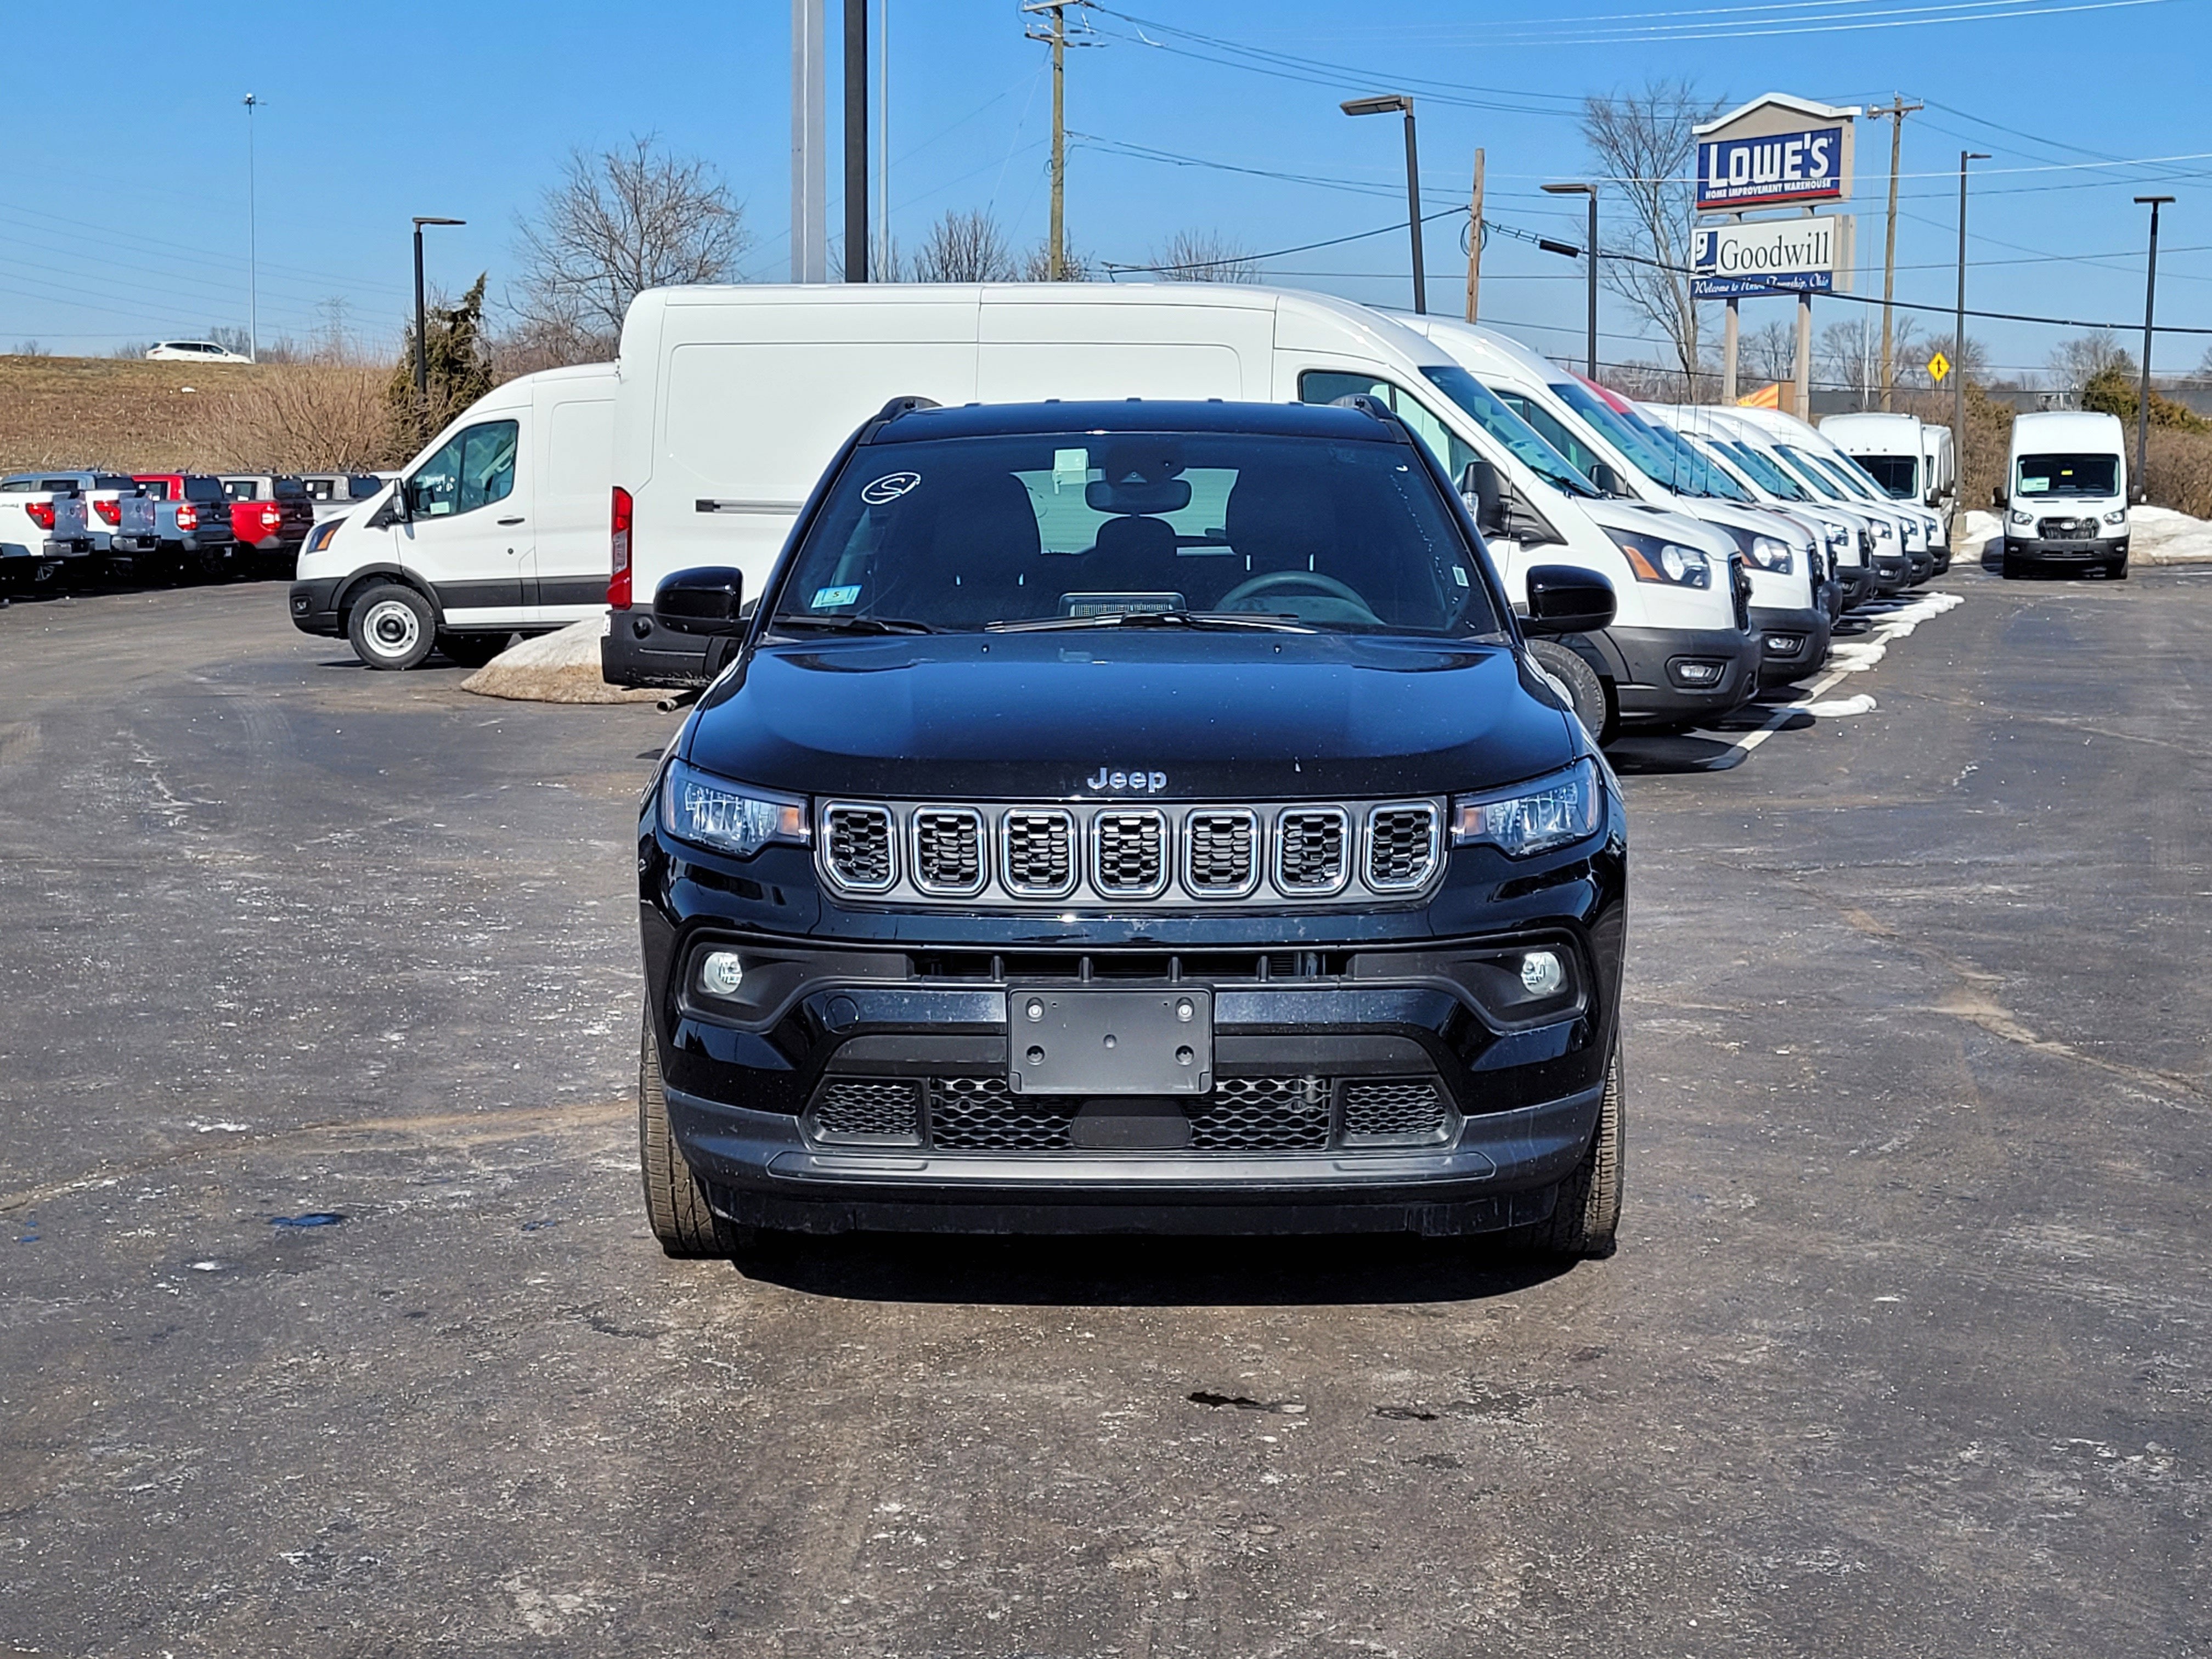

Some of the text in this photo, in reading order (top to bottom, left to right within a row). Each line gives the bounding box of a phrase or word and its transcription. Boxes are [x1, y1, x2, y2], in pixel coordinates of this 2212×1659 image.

[1708, 133, 1829, 189] LOWE'S
[1706, 178, 1831, 199] HOME IMPROVEMENT WAREHOUSE
[1720, 230, 1829, 270] Goodwill
[1695, 281, 1730, 294] Welcome
[1731, 283, 1739, 292] to
[1809, 273, 1829, 287] Ohio
[1087, 768, 1167, 793] Jeep
